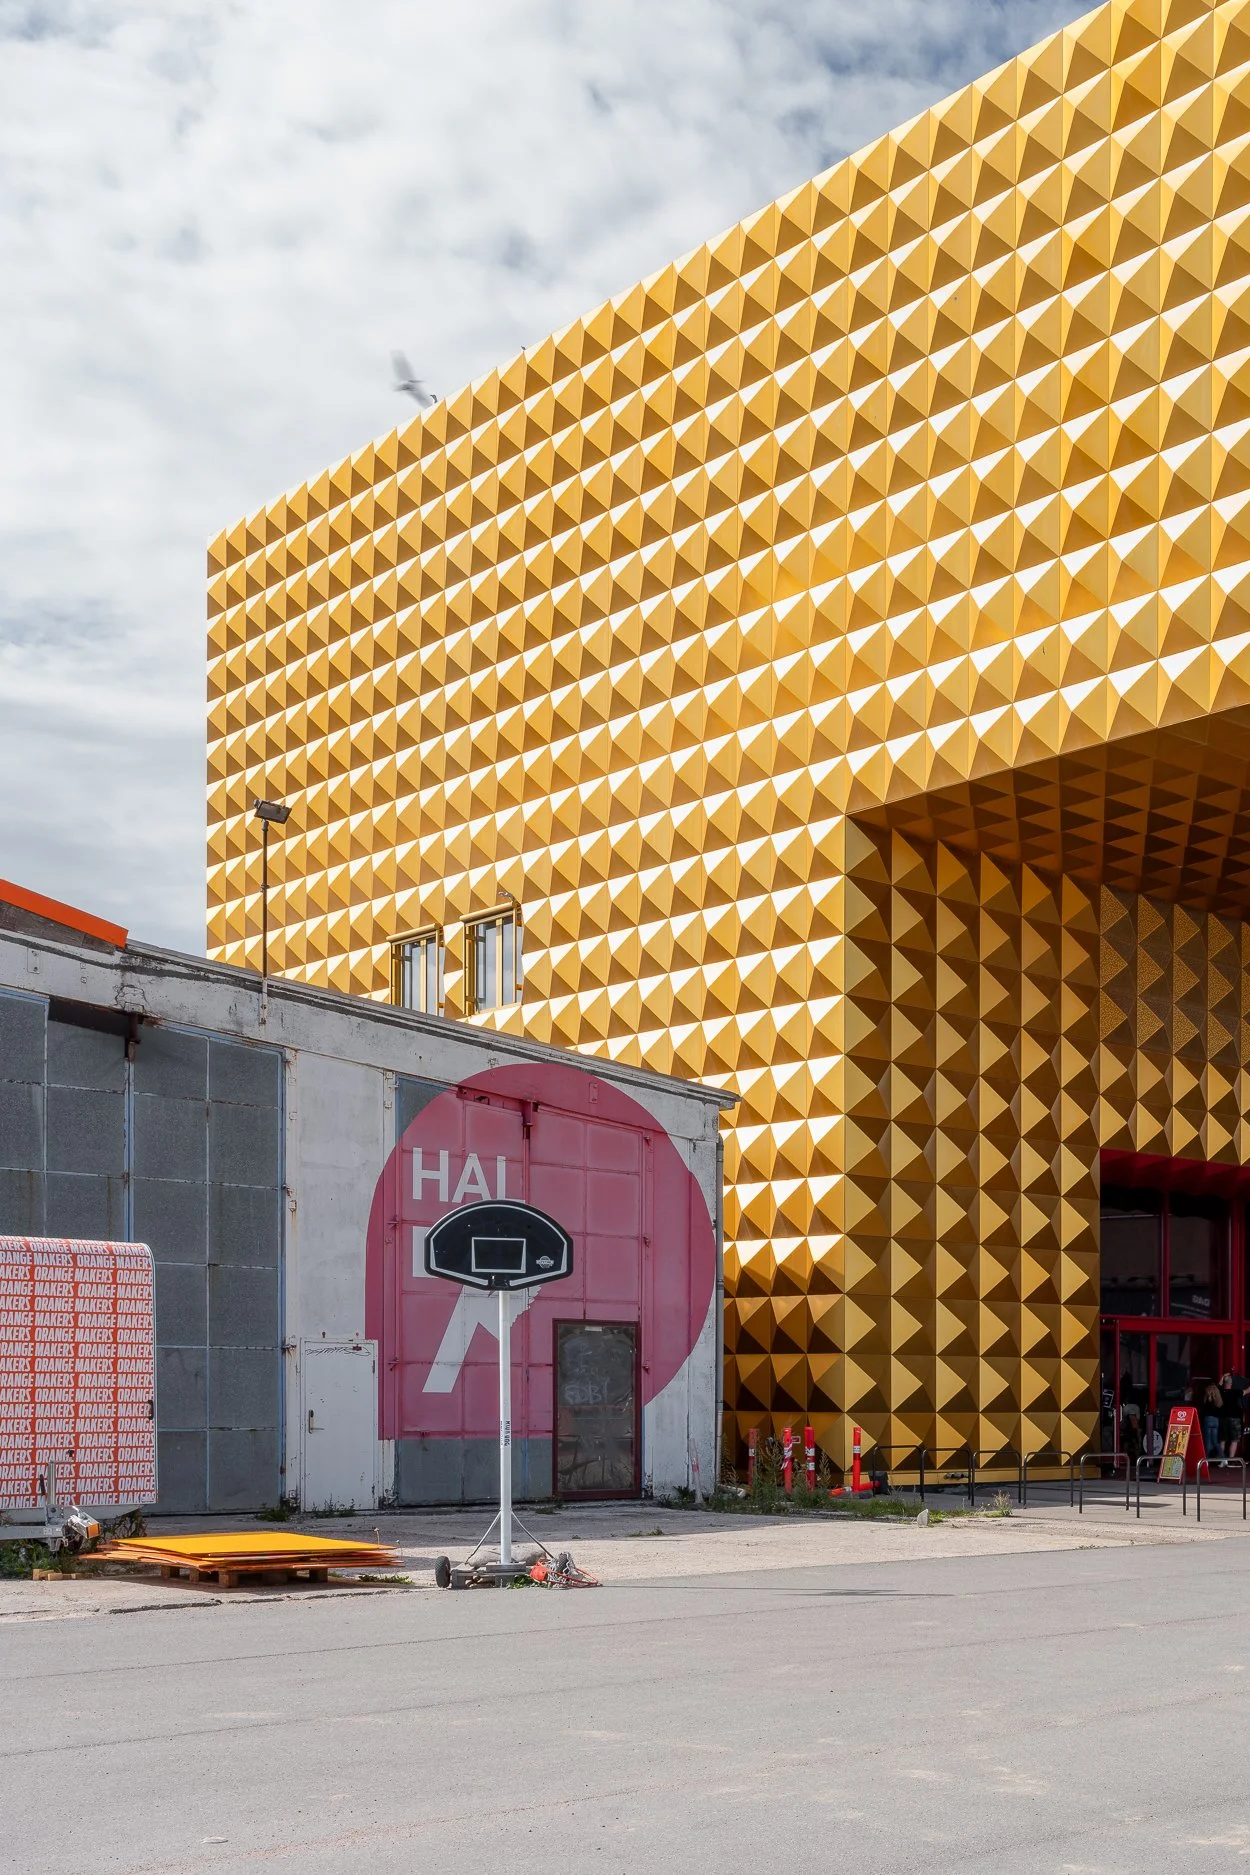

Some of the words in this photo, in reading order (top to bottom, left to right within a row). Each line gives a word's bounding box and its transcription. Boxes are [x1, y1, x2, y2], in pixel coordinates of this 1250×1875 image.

[412, 1147, 526, 1204] HAL
[30, 1243, 69, 1253] ORANGE
[69, 1244, 110, 1255] MAKERS
[113, 1246, 149, 1256] ORANG
[33, 1253, 73, 1266] MAKERS
[76, 1255, 115, 1268] ORANGE
[34, 1266, 73, 1281] ORANGE
[74, 1268, 113, 1283] MAKERS
[117, 1270, 152, 1284] ORANGE
[34, 1282, 74, 1297] MAKERS
[78, 1284, 116, 1298] ORANGE
[34, 1297, 74, 1312] ORANGE
[75, 1298, 114, 1313] MAKERS
[117, 1300, 153, 1314] ORANGE
[0, 1311, 34, 1326] RANGE
[35, 1312, 74, 1327] MAKERS
[78, 1313, 116, 1328] ORANGE
[35, 1328, 74, 1342] ORANGE
[75, 1329, 114, 1342] MAKERS
[117, 1329, 153, 1343] ORANGE
[0, 1342, 34, 1356] RANGE
[35, 1343, 75, 1357] MAKERS
[78, 1343, 116, 1357] ORANGE
[35, 1358, 74, 1372] ORANGE
[75, 1358, 114, 1373] MAKERS
[117, 1359, 154, 1373] ORANGE
[0, 1373, 34, 1387] RANGE
[35, 1373, 75, 1387] MAKERS
[78, 1373, 116, 1387] ORANGE
[35, 1388, 74, 1402] ORANGE
[75, 1388, 114, 1402] MAKERS
[0, 1403, 34, 1418] RANGE
[35, 1403, 75, 1417] MAKERS
[78, 1403, 116, 1417] ORANGE
[118, 1403, 151, 1417] MAKER
[35, 1419, 74, 1433] ORANGE
[76, 1419, 114, 1432] MAKERS
[118, 1418, 154, 1432] ORANGE
[0, 1434, 35, 1449] RANGE
[36, 1434, 75, 1448] MAKERS
[79, 1433, 117, 1447] ORANGE
[76, 1448, 114, 1462] MAKERS
[118, 1447, 154, 1461] ORANGE
[0, 1465, 35, 1479] RANGE
[36, 1464, 76, 1479] MERS
[79, 1463, 117, 1477] ORANGE
[76, 1478, 115, 1493] MAKERS
[118, 1477, 154, 1491] ORANGE
[0, 1495, 35, 1508] RANGE
[80, 1493, 118, 1506] ORANGE
